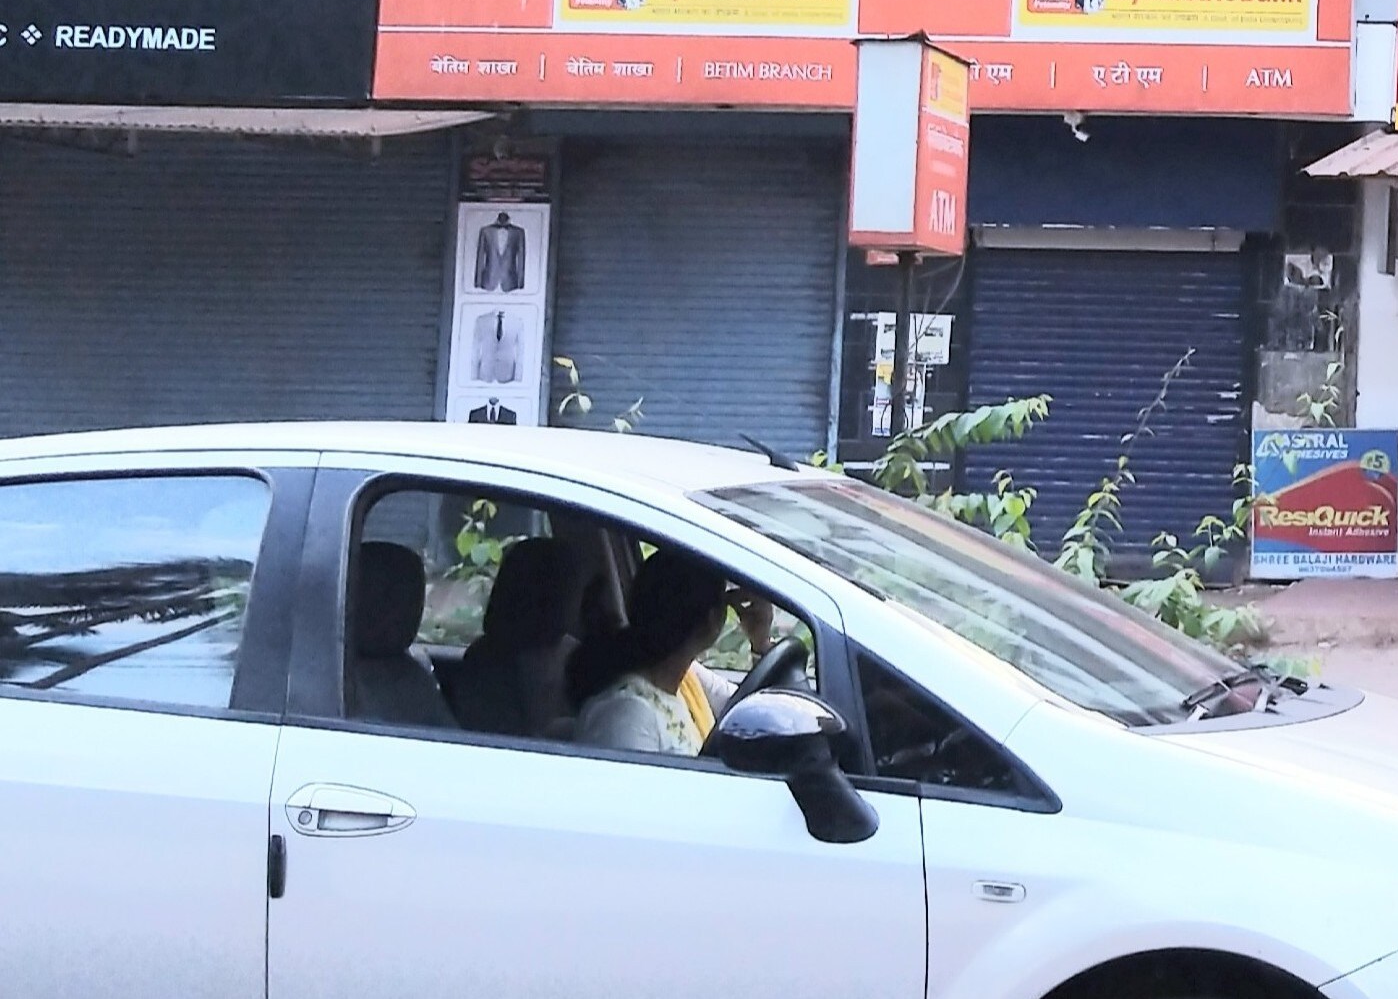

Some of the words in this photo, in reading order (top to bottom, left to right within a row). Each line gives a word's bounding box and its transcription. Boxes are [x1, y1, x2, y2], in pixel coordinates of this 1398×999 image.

[55, 25, 216, 50] READYMADE
[703, 61, 754, 79] BETIM
[758, 61, 832, 81] BRANCH
[1245, 67, 1293, 88] ATM
[929, 188, 956, 236] ATM
[1259, 505, 1391, 529] ResiQuick
[1308, 527, 1343, 537] Instant
[1345, 527, 1390, 537] Adhesive
[1254, 554, 1289, 565] SHREE
[1293, 554, 1332, 565] BALAJI
[1335, 554, 1397, 565] HARDWARE
